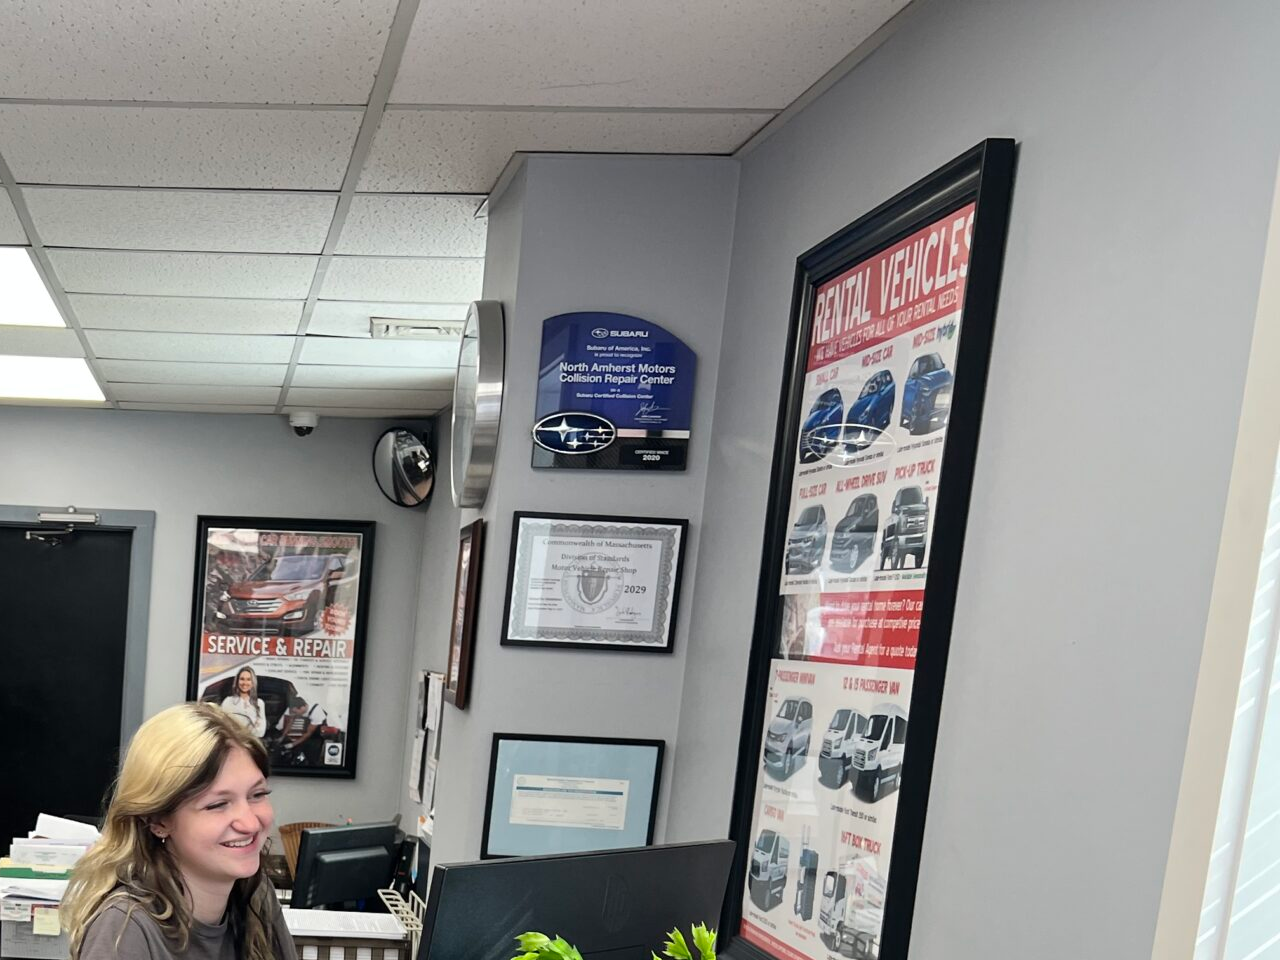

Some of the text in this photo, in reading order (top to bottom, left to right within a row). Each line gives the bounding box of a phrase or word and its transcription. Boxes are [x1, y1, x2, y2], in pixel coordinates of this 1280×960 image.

[811, 267, 871, 344] RENTAL
[862, 325, 876, 342] FOR
[875, 319, 887, 336] ALL
[886, 314, 896, 332] OF
[896, 308, 911, 327] YOUR
[912, 296, 936, 320] RENTAL
[937, 287, 959, 307] NEEDS
[559, 362, 676, 374] North Amherst Motors
[559, 373, 675, 385] Collision Repair Center
[894, 459, 935, 480] PICK-UP TRUCK
[605, 541, 653, 549] Massachusetts
[623, 585, 647, 594] 2029
[208, 635, 347, 658] SERVICE & REPAIR
[860, 679, 888, 694] PASSENGER
[889, 682, 900, 695] VAN
[864, 837, 881, 855] TRUCK
